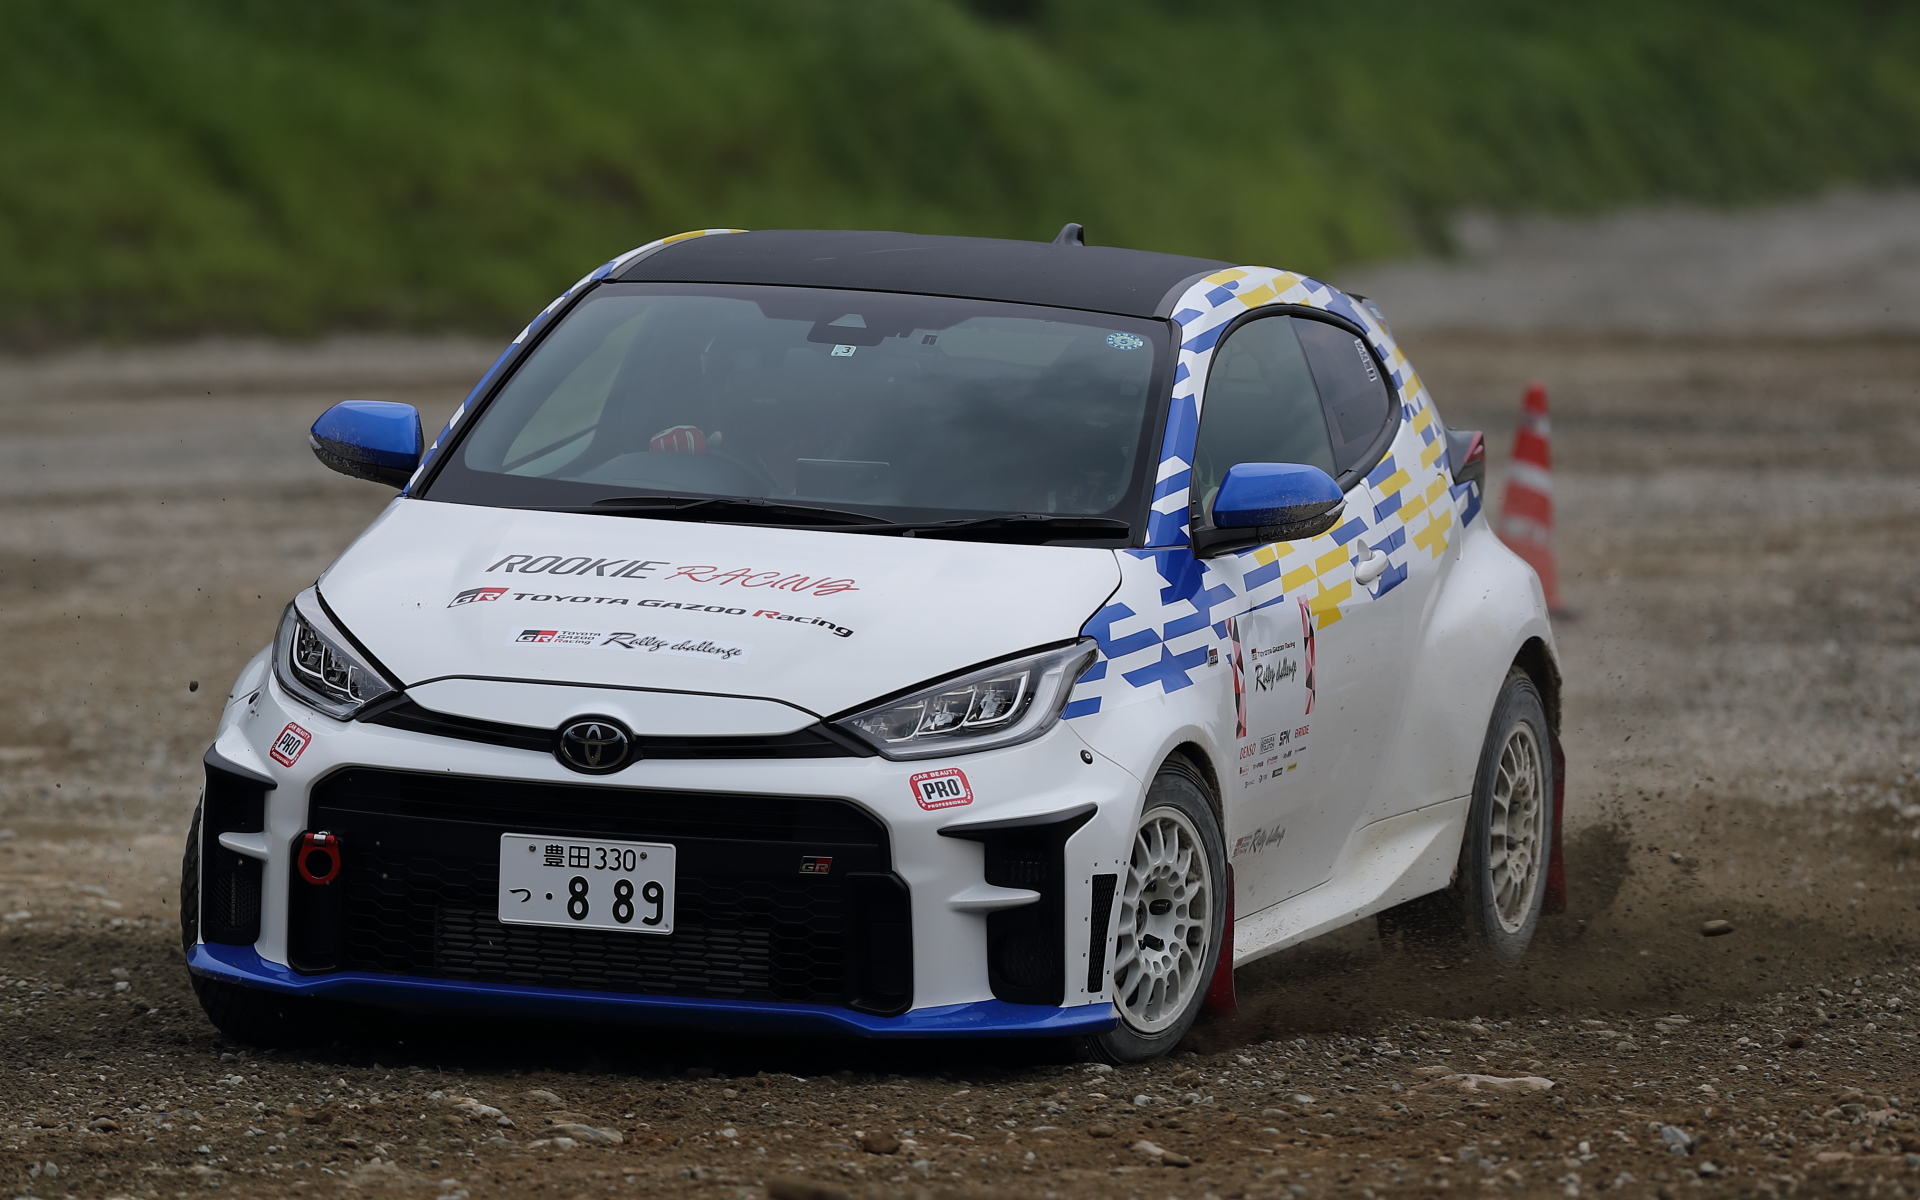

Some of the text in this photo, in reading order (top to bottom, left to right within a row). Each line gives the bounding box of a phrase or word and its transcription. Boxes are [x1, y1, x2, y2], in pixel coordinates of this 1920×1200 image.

[841, 346, 852, 354] 3
[484, 554, 860, 597] ROOKIE RACING
[448, 590, 855, 638] GR TOYOTA GAZOO Racing
[516, 633, 555, 643] GR
[599, 631, 743, 660] Rally challenge
[1278, 728, 1292, 747] SPK
[1294, 724, 1310, 739] BRIDE
[277, 732, 302, 756] PRO
[1239, 742, 1257, 761] DENSO
[912, 769, 959, 782] CAR BEAUTY
[922, 778, 961, 800] PRO
[927, 799, 968, 809] PROFESSIONAL
[800, 859, 831, 874] GR
